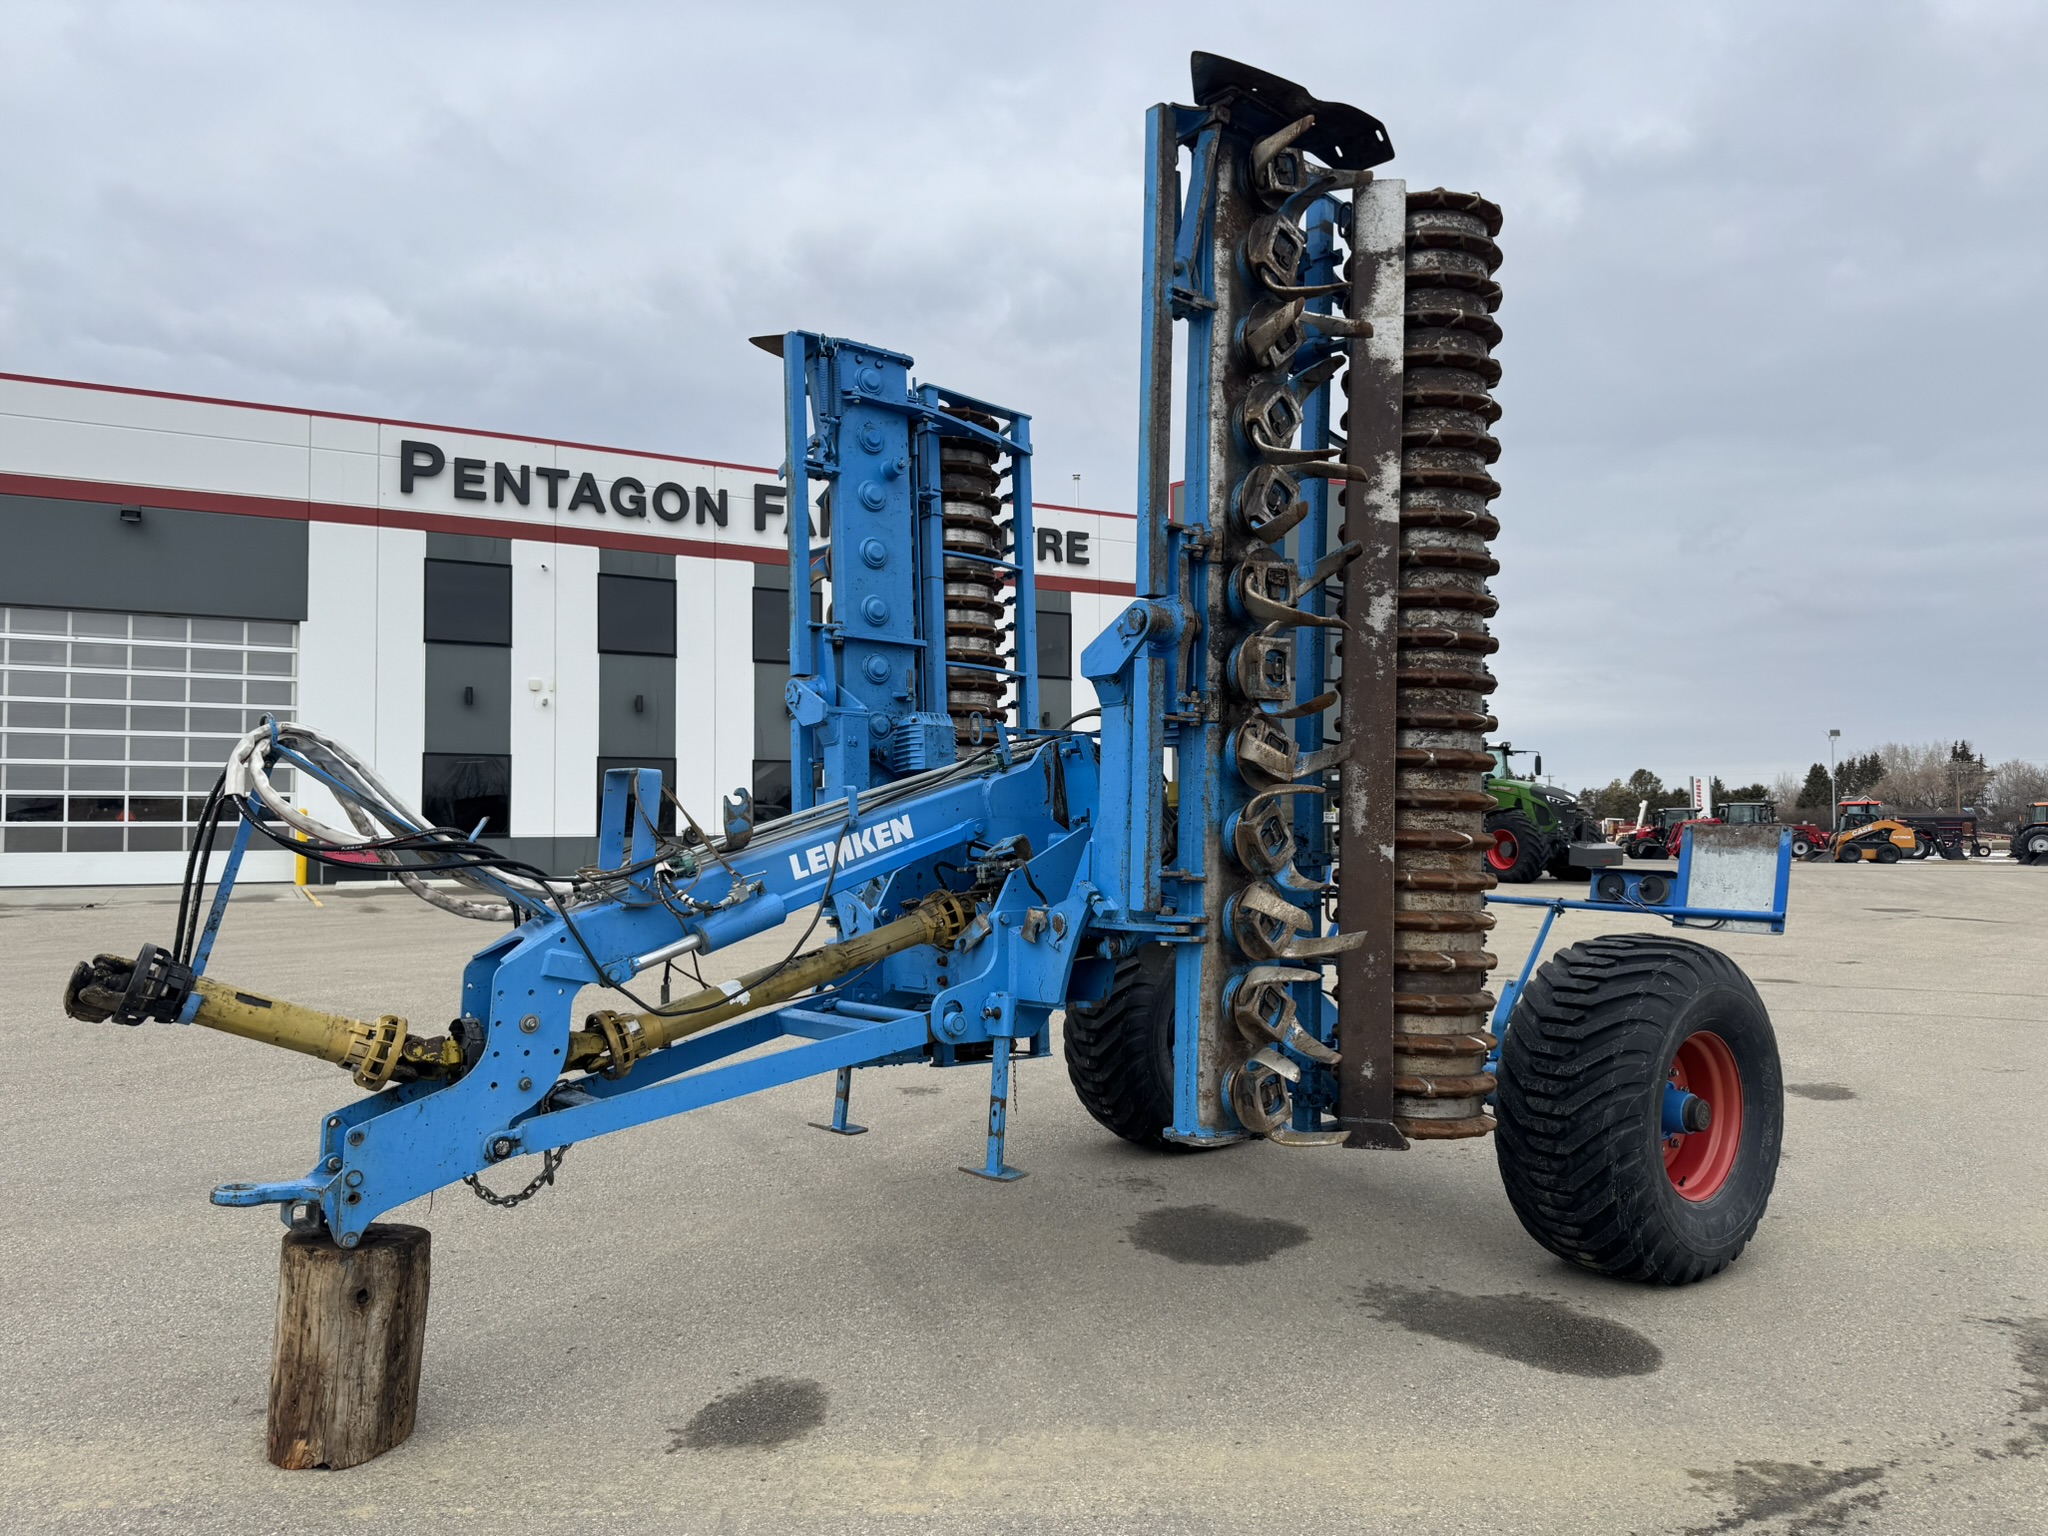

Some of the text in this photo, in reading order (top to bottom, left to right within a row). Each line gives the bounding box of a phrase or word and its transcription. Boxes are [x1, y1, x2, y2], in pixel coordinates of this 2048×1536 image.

[400, 440, 728, 527] PENTAGON
[788, 814, 914, 881] LEMKEN
[1851, 823, 1873, 837] CASE
